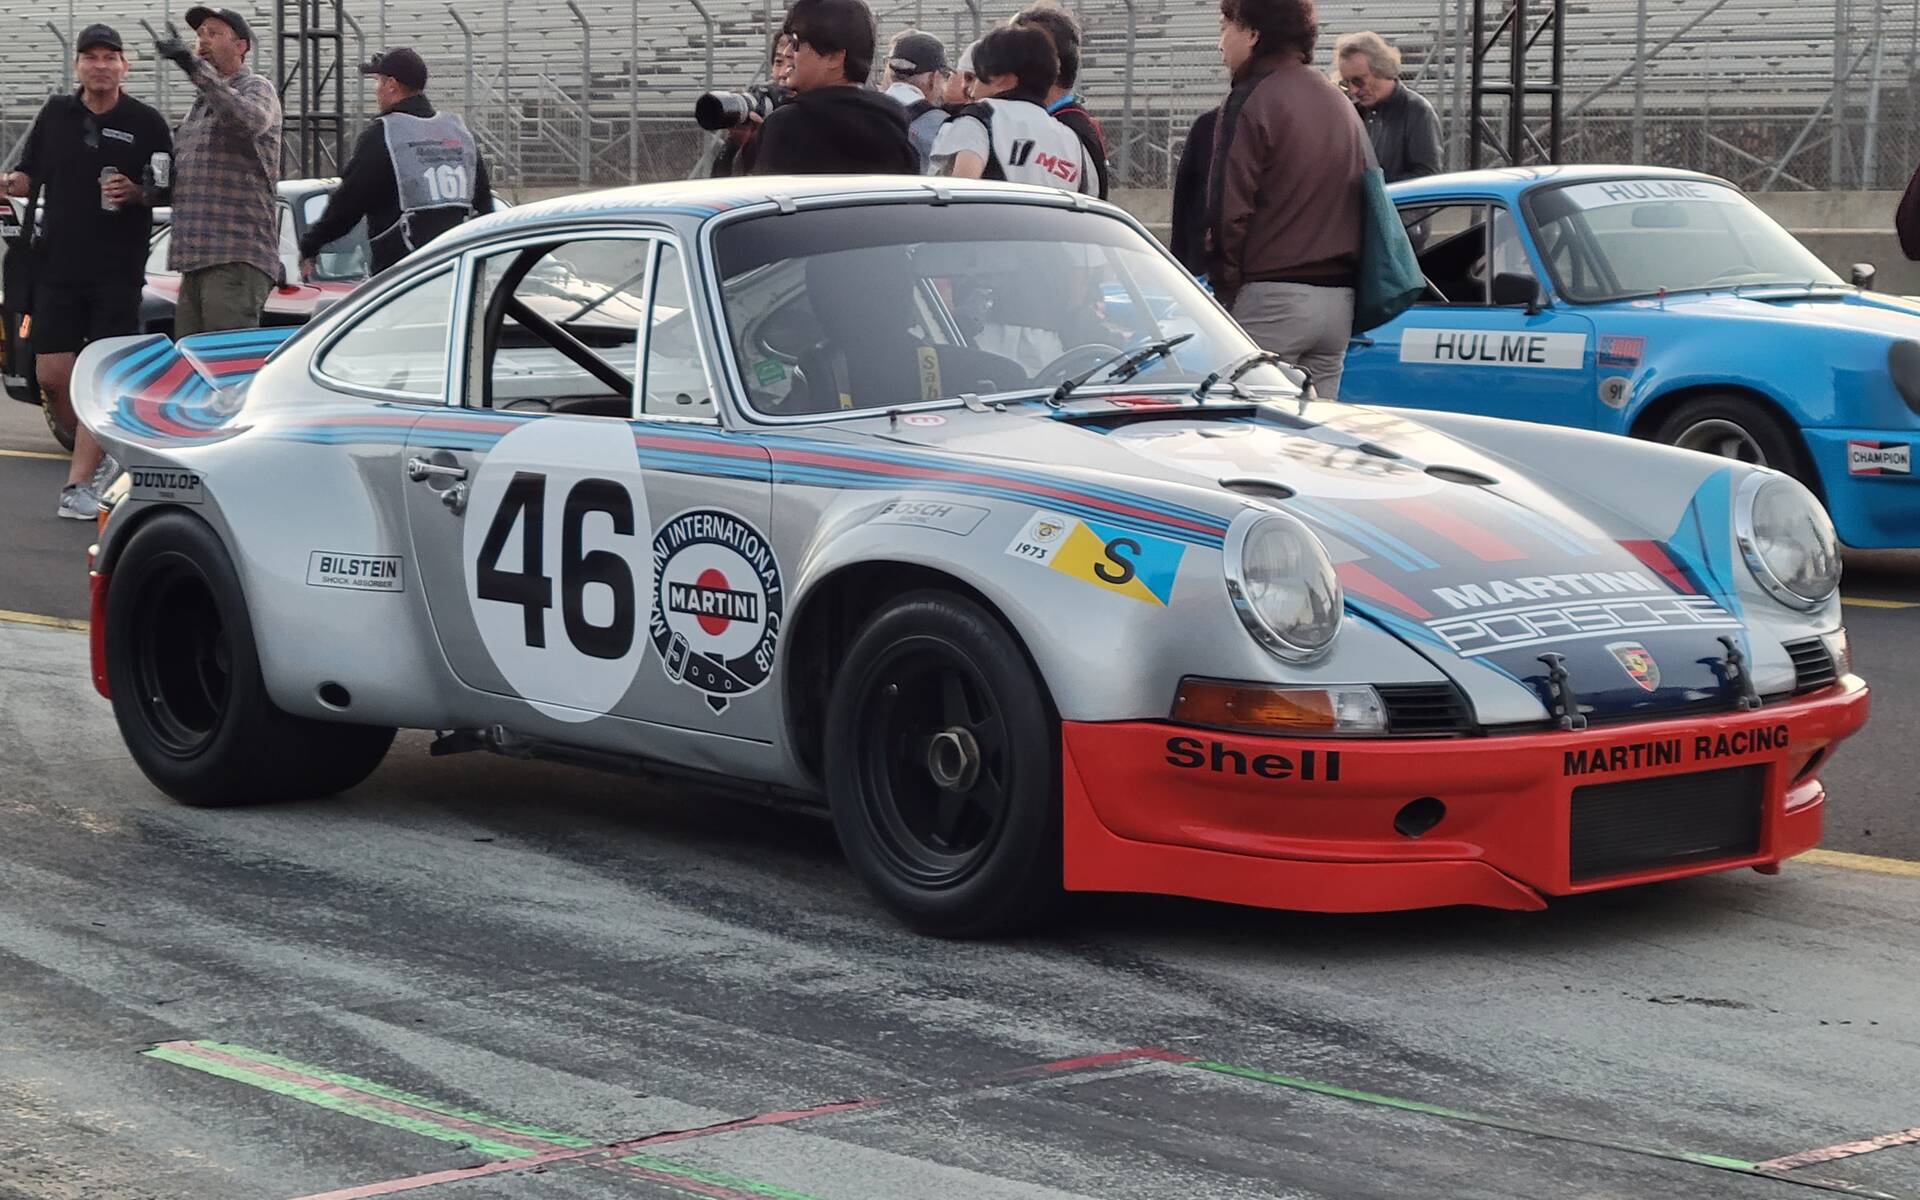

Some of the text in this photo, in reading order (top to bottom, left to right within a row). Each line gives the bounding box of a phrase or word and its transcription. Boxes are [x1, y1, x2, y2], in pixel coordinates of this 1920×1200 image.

[424, 165, 467, 201] 161
[1600, 183, 1708, 200] HULME
[1435, 333, 1548, 363] HULME
[1853, 451, 1908, 464] CHAMPION
[132, 472, 200, 489] DUNLOP
[320, 557, 396, 578] BILSTEIN
[477, 471, 635, 660] 46
[1015, 542, 1048, 559] 1973
[1094, 537, 1142, 585] S
[321, 576, 393, 588] SHOCK ABSORBER
[667, 514, 780, 595] INTERNATIONAL
[755, 611, 780, 672] CLUB
[1432, 571, 1661, 610] MARTINI
[672, 585, 756, 619] MARTINI
[1432, 600, 1739, 651] PORSCHE
[1165, 736, 1340, 782] Shell
[1563, 725, 1789, 776] MARTINI RACING
